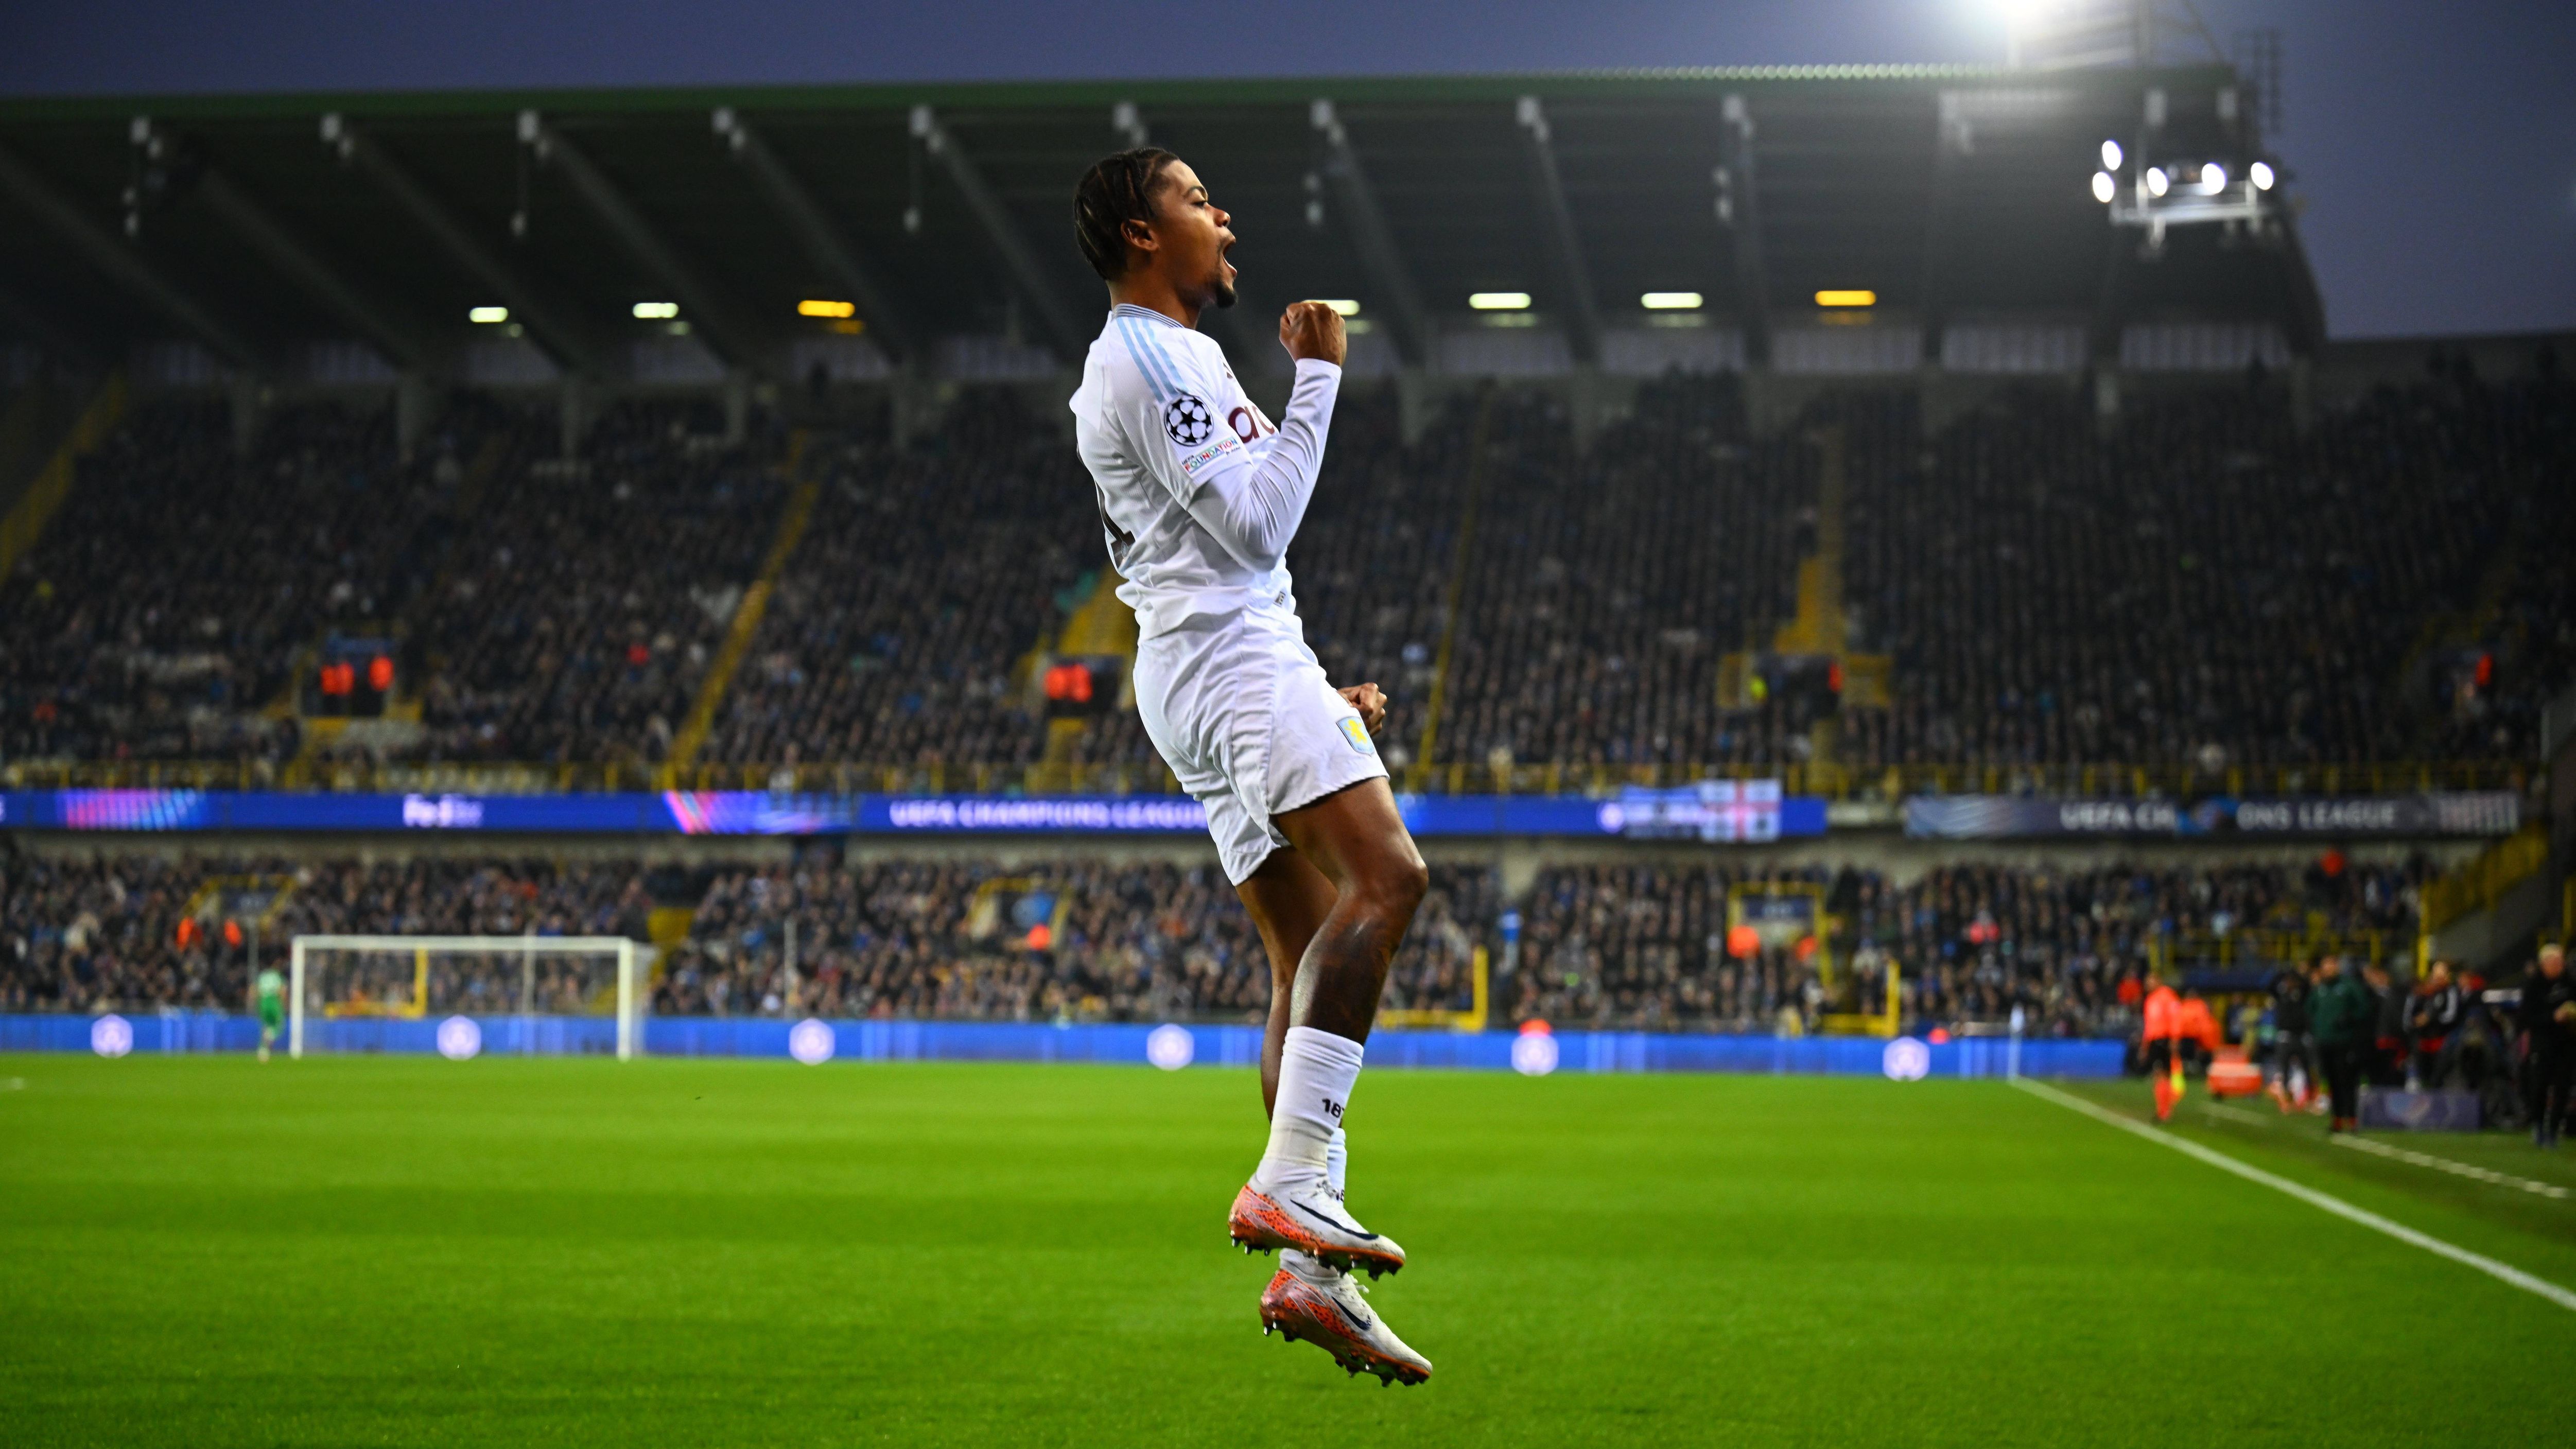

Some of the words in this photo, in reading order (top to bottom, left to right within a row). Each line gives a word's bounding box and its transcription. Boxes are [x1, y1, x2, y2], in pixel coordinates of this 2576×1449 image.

[1185, 438, 1238, 472] FOUNDATION
[890, 801, 956, 827] UEFA
[958, 801, 1110, 828] CHAMPIONS
[2060, 802, 2132, 830] UEFA
[2298, 801, 2394, 830] LEAGUE
[1321, 1098, 1345, 1118] 18
